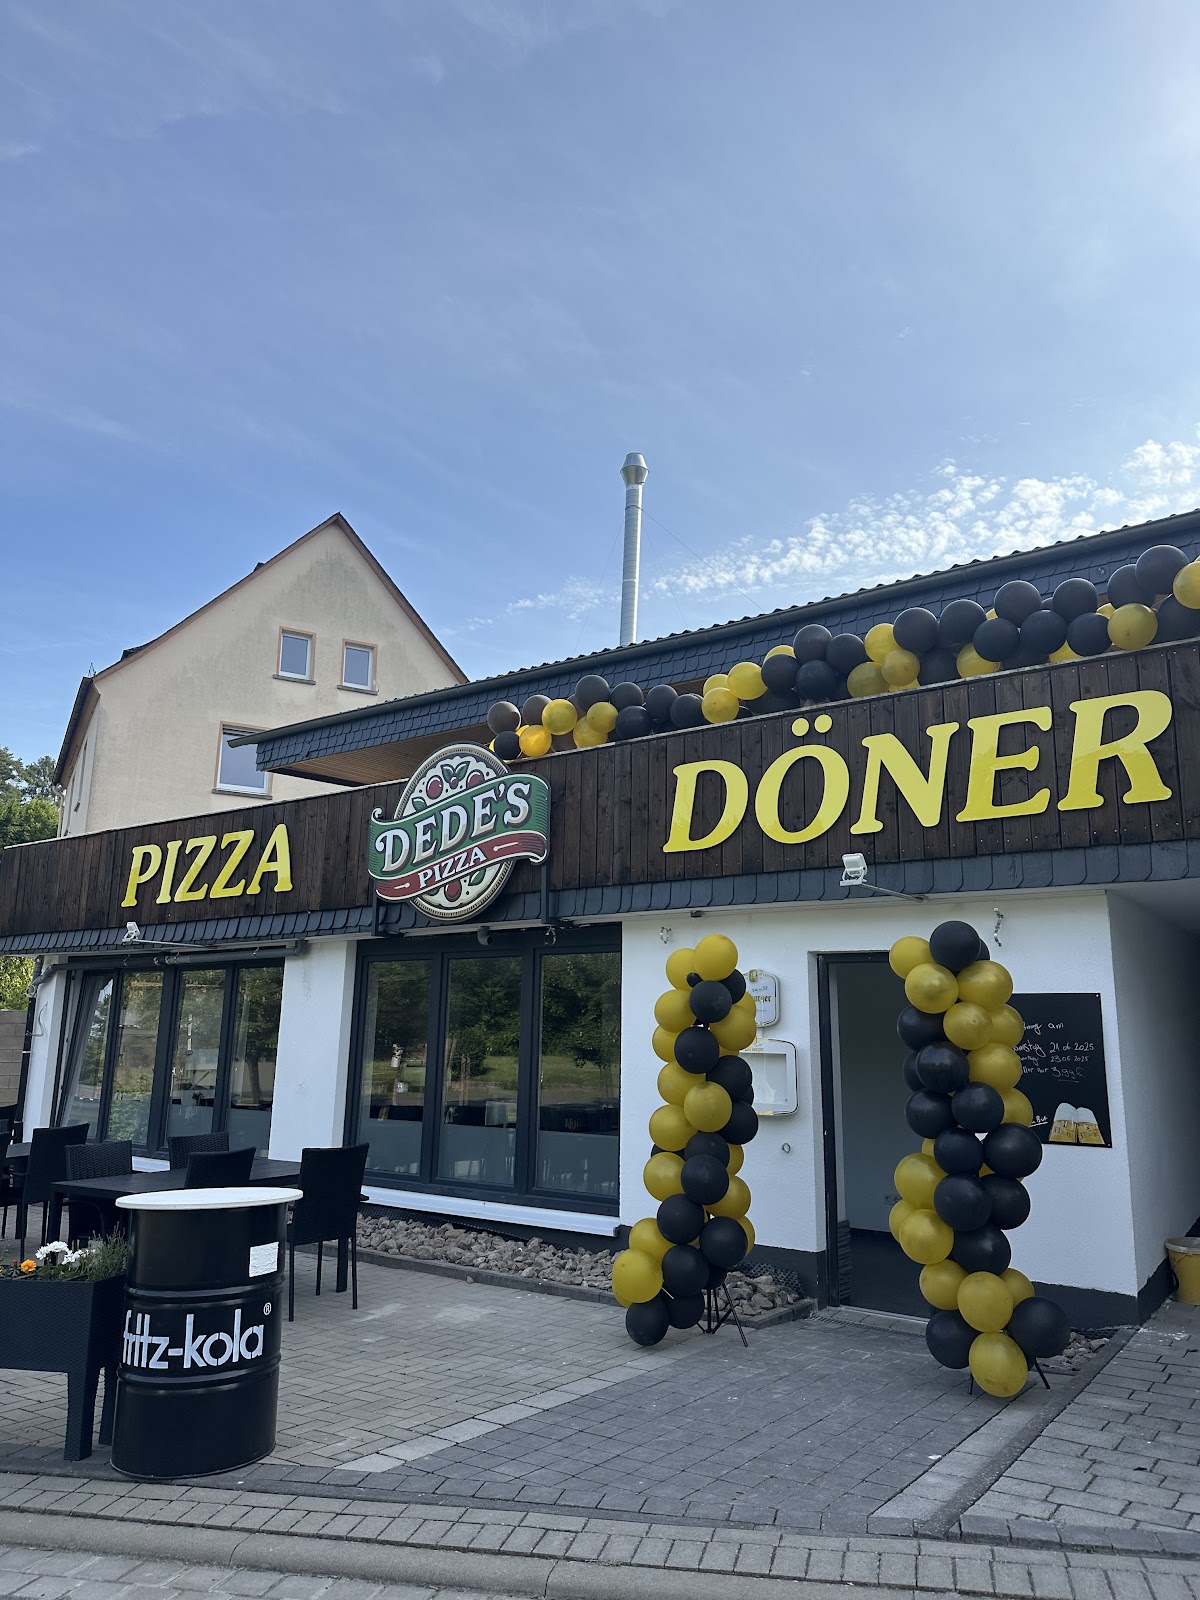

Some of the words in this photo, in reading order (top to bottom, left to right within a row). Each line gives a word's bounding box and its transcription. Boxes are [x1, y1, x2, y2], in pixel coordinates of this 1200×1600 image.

[662, 689, 1173, 853] DÖNER
[375, 782, 531, 873] DEDE'S
[121, 823, 293, 907] PIZZA
[417, 847, 487, 888] PIZZA
[1048, 1022, 1064, 1030] am
[123, 1308, 264, 1369] fritz-kola
